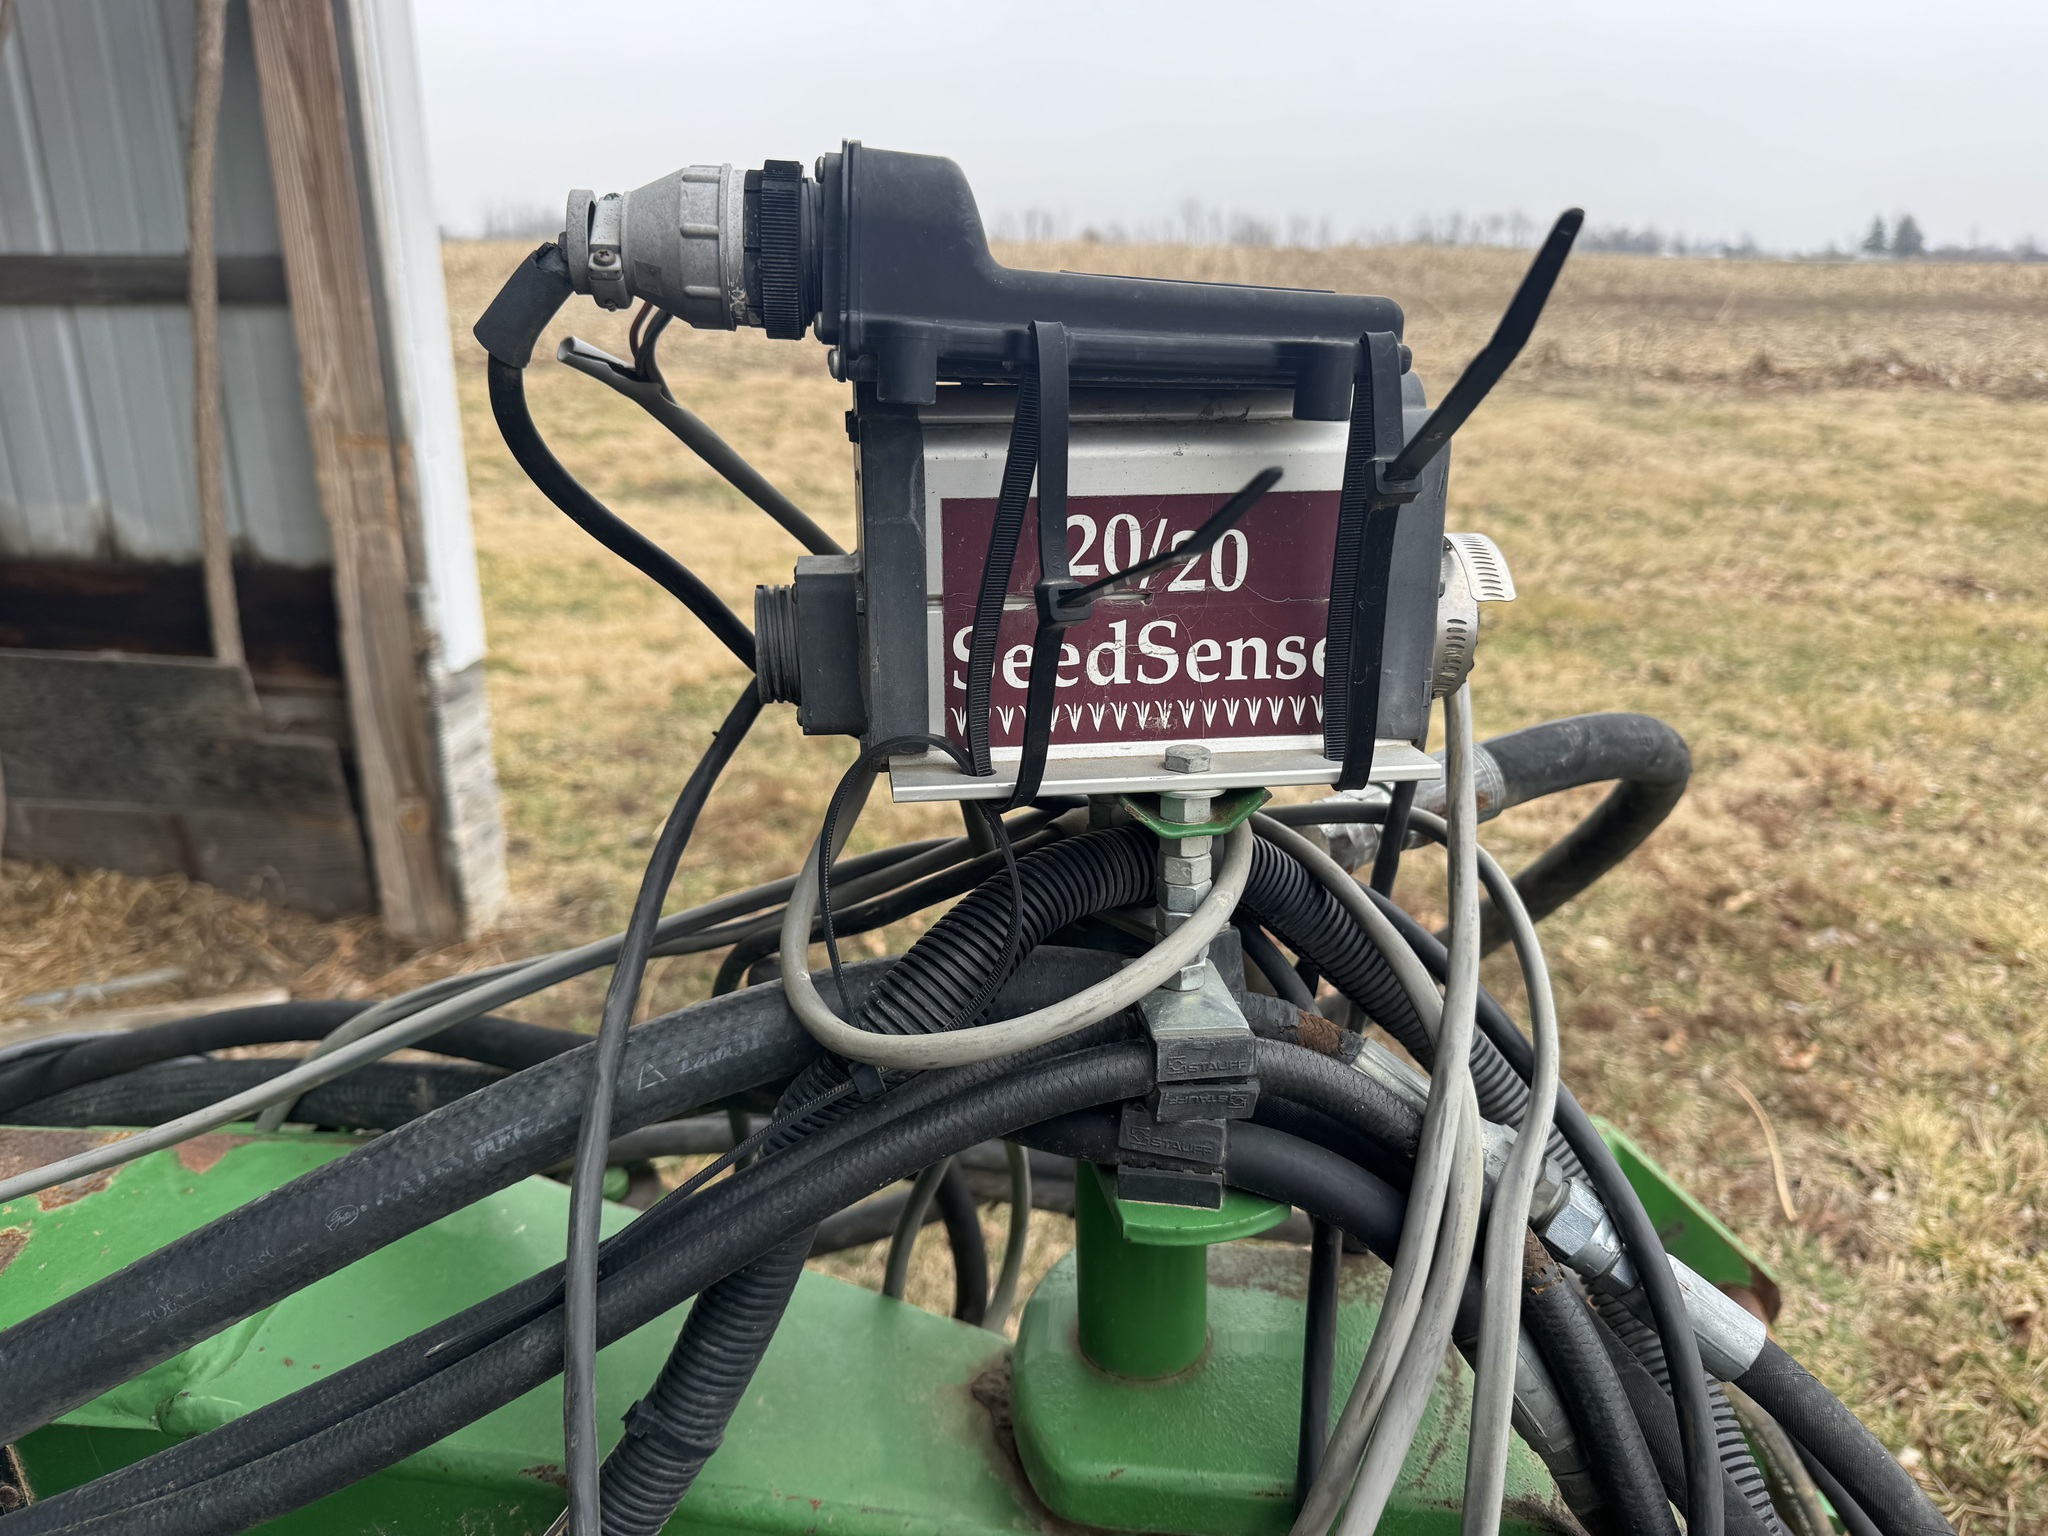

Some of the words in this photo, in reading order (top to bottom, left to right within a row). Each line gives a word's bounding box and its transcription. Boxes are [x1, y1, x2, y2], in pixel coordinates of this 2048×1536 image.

[1066, 513, 1249, 592] 20/20
[1187, 1060, 1248, 1074] STAUFF
[1150, 1136, 1214, 1157] STAUFF
